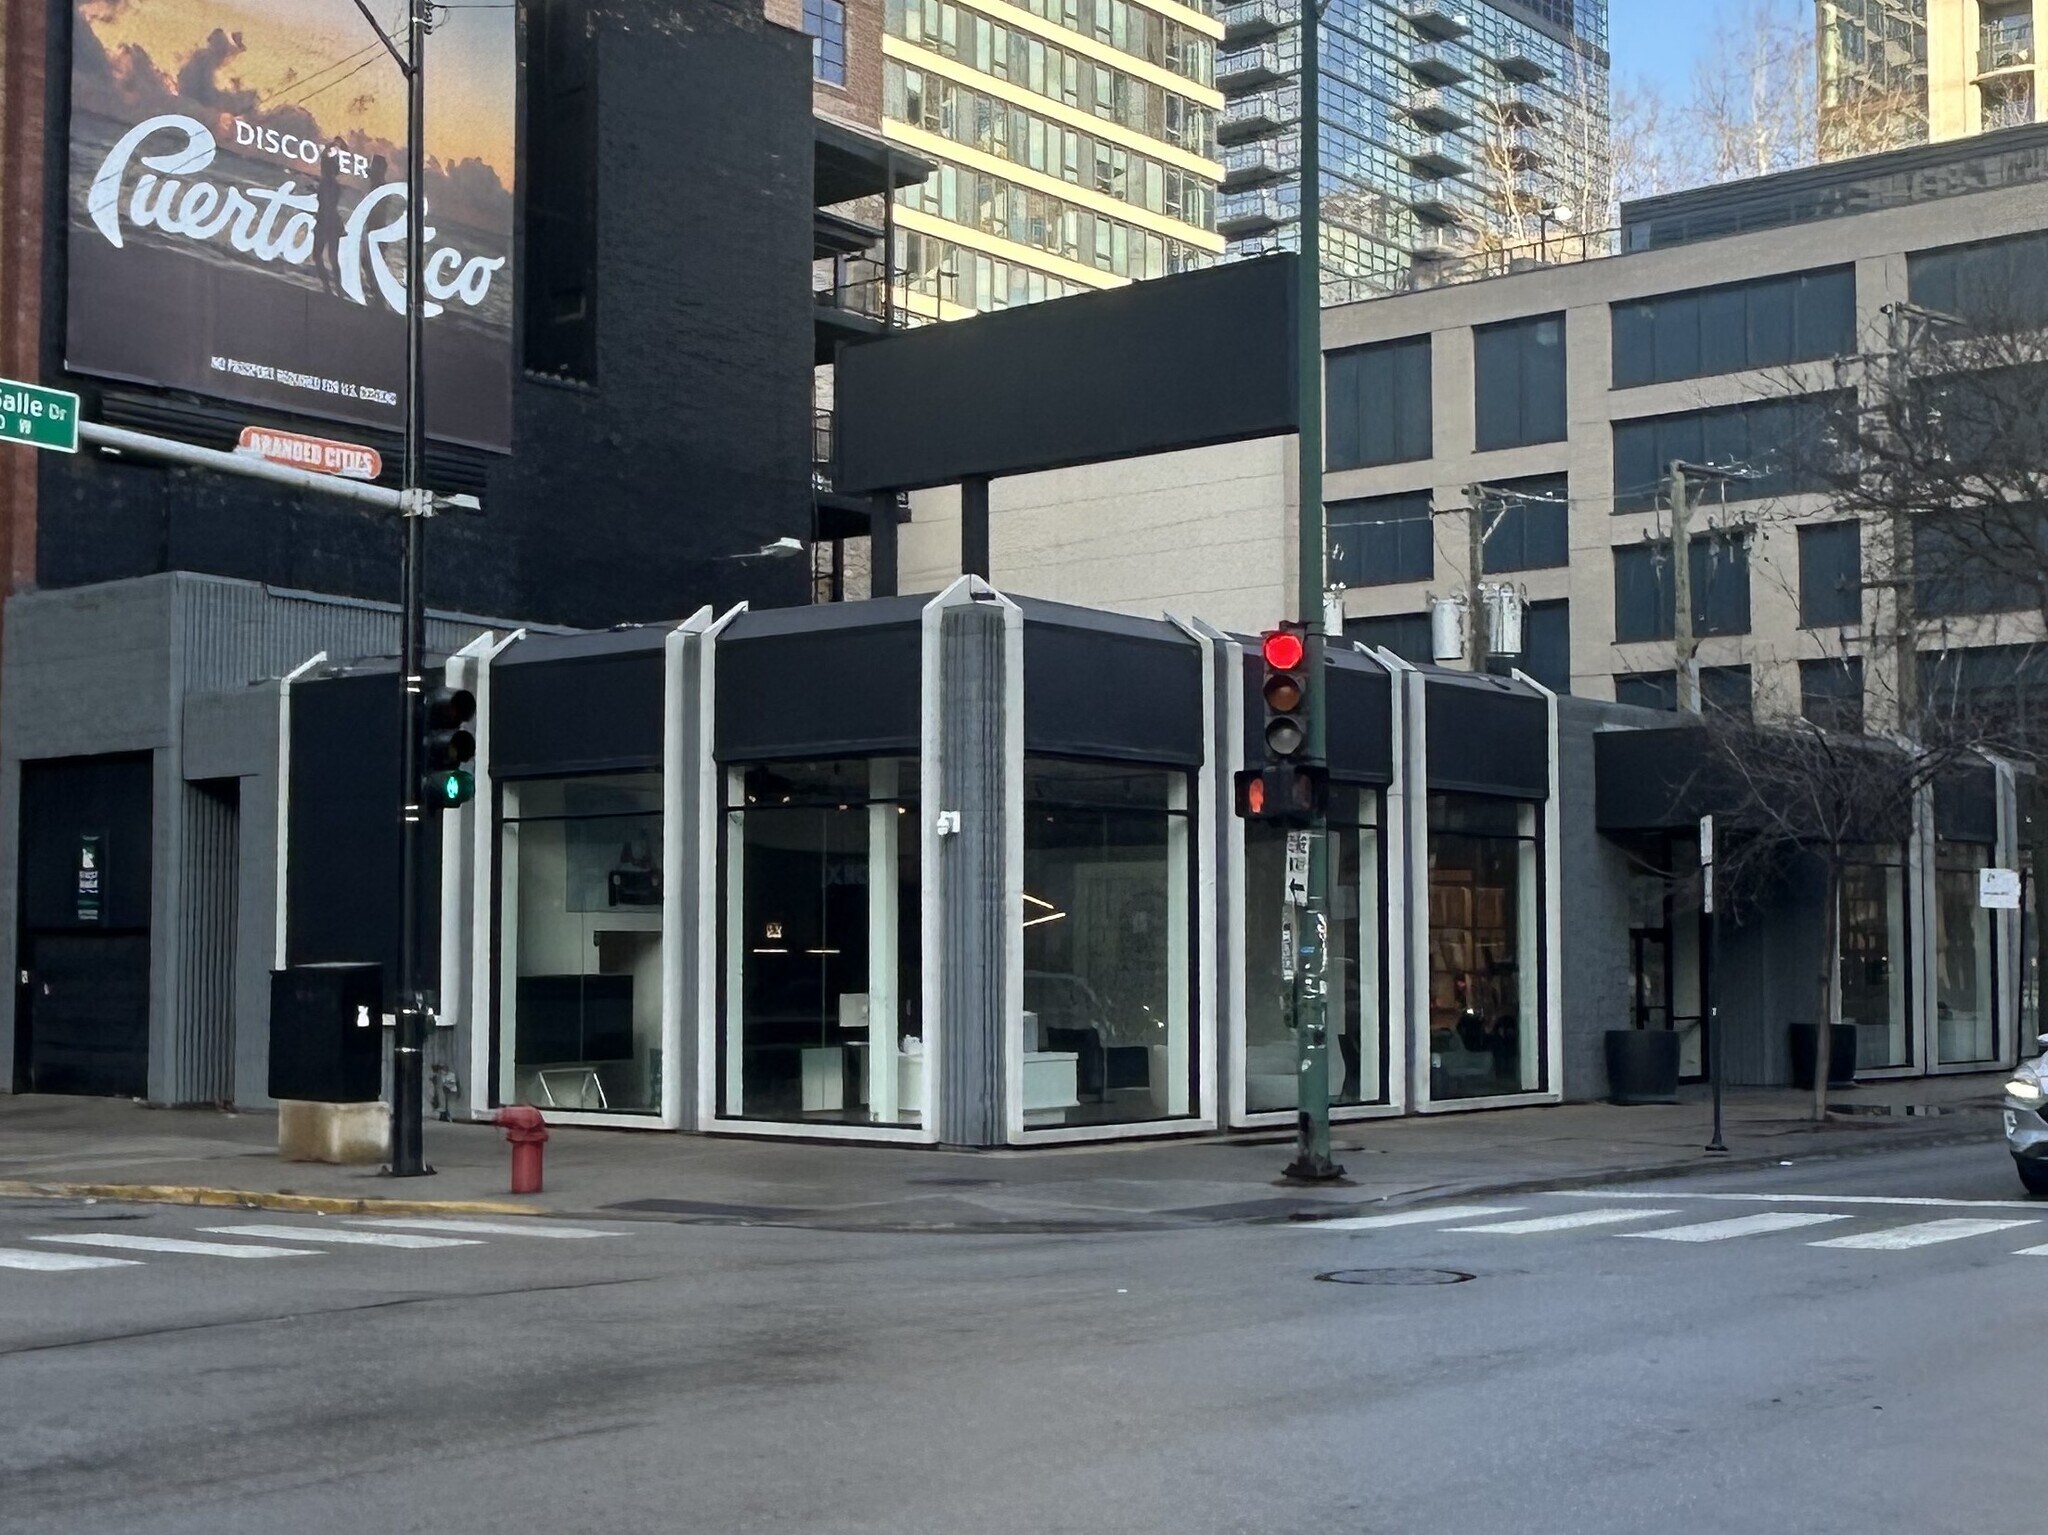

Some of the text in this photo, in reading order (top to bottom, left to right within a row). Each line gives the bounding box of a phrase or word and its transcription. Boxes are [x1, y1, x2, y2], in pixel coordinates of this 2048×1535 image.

[88, 114, 506, 318] Puerto Rco
[0, 388, 67, 421] alle Dr
